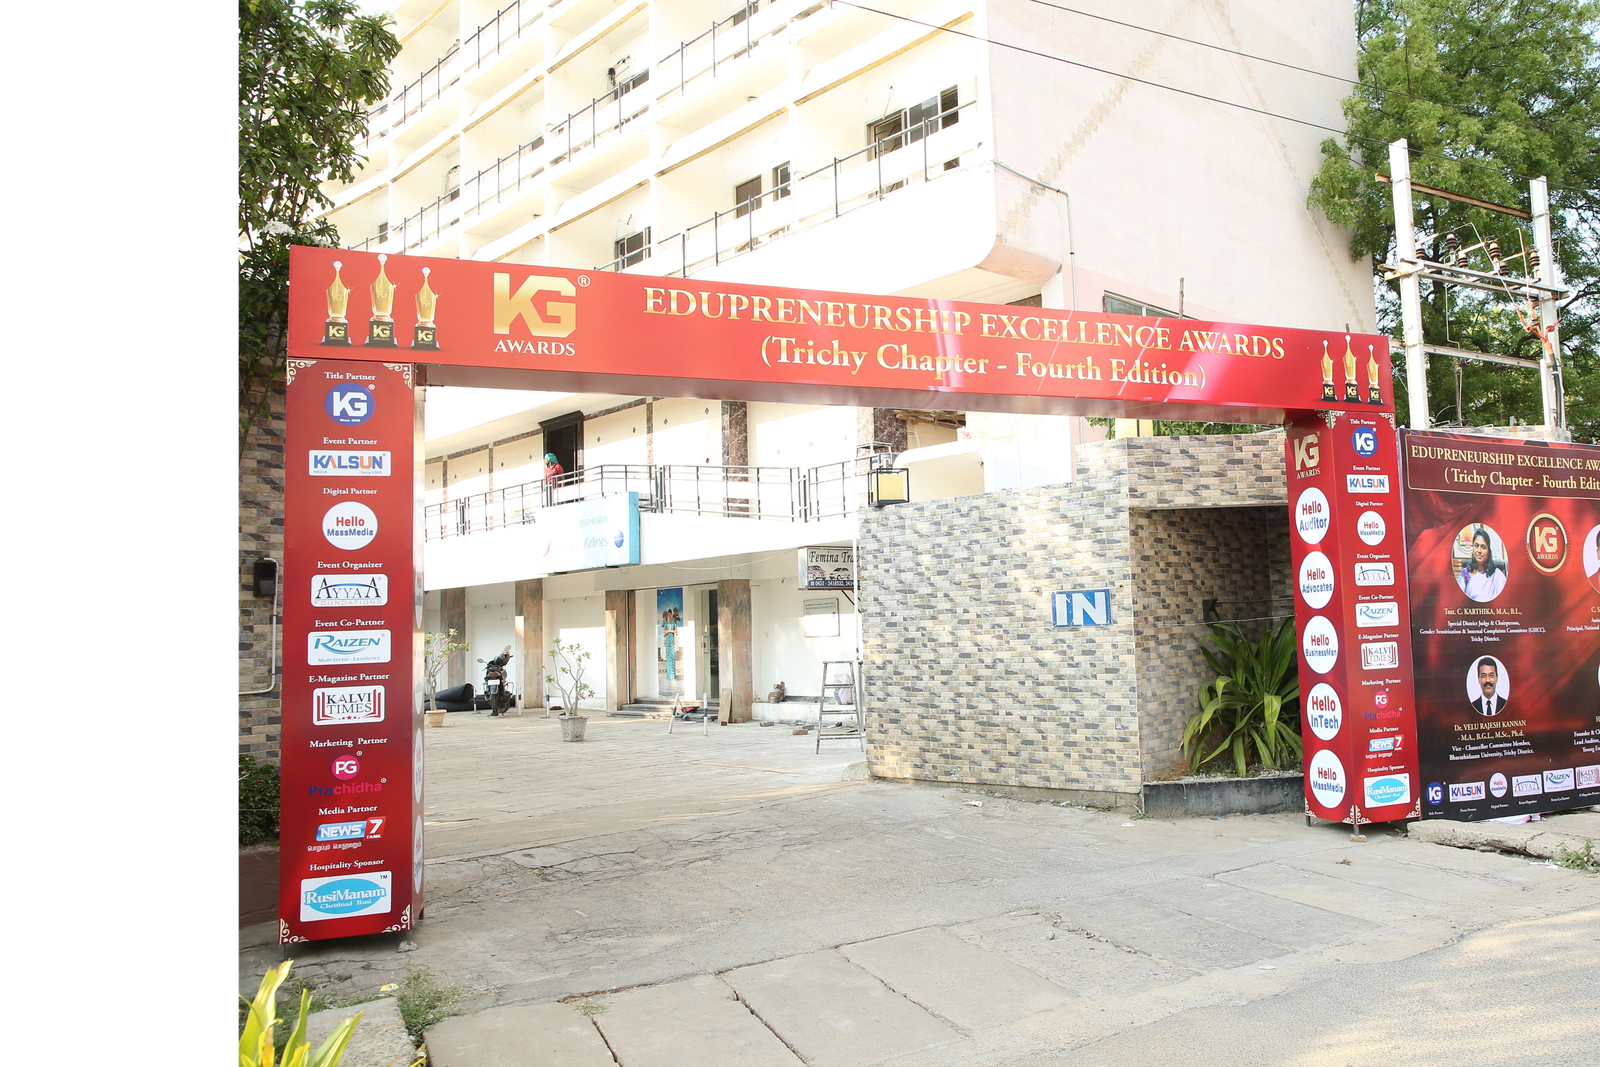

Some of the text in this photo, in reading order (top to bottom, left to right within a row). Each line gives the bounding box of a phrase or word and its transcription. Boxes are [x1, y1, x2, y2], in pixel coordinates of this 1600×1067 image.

[493, 272, 576, 338] KG
[642, 286, 1286, 360] EDUPRENEURSHIP EXCELLENCE AWARDS
[494, 339, 576, 357] AWARDS
[761, 335, 868, 376] (Trichy
[876, 342, 989, 381] Chapter
[1015, 352, 1102, 381] Fourth
[1109, 357, 1206, 391] Edition)
[324, 371, 376, 381] Title Partner
[333, 391, 368, 417] KG
[348, 437, 378, 445] Partner
[1355, 432, 1374, 451] KG
[1293, 433, 1320, 471] KG
[1411, 445, 1600, 471] EDUPRENEURSHIP EXCELLENCE AW
[313, 455, 383, 469] KALSUN
[1296, 467, 1320, 479] AWARDS
[1349, 478, 1385, 488] KALSUN
[1489, 471, 1533, 490] Chapter
[1542, 474, 1577, 489] Fourth
[323, 487, 349, 496] Digital
[1301, 500, 1322, 516] Hello
[336, 516, 365, 526] Hello
[1299, 516, 1327, 532] Auditor
[326, 528, 374, 536] MassMedia
[584, 538, 608, 549] Airlines
[1534, 526, 1558, 552] KG
[809, 551, 839, 563] Femina
[342, 561, 383, 570] Organizer
[1306, 568, 1325, 581] Hello
[1302, 583, 1332, 593] Advocates
[1055, 592, 1107, 625] IN
[1359, 605, 1394, 616] RAIZEN
[340, 619, 385, 627] Co-Partner
[312, 634, 381, 650] RAIZEN
[1310, 634, 1330, 646] Hello
[1305, 648, 1337, 657] BusinessMan
[1368, 646, 1391, 656] KALVI
[1368, 654, 1392, 663] TIMES
[309, 675, 358, 684] E-Magazine
[326, 693, 372, 704] KALVI
[1311, 695, 1336, 712] Hello
[1375, 694, 1388, 705] PG
[326, 703, 372, 714] TIMES
[1363, 710, 1401, 720] Prachidha
[1310, 714, 1339, 729] InTech
[1463, 723, 1479, 731] VELU
[1480, 721, 1501, 730] RAJESH
[1501, 720, 1526, 728] KANNAN
[309, 737, 388, 748] Marketing Partner
[1371, 736, 1403, 749] NEWS 7
[335, 760, 357, 775] PG
[1317, 766, 1337, 781] Hello
[1545, 772, 1571, 782] RAIZEN
[309, 782, 382, 796] Prachidha
[1312, 780, 1343, 793] MassMedia
[1367, 785, 1407, 796] RusiManam
[1451, 785, 1482, 797] KALSUN
[1428, 786, 1442, 801] KG
[318, 805, 378, 816] Media Partner
[320, 818, 383, 838] NEWS 7
[309, 859, 384, 872] Hospitality Sponsor
[305, 888, 385, 905] RusiManam
[319, 901, 353, 909] Chettinad
